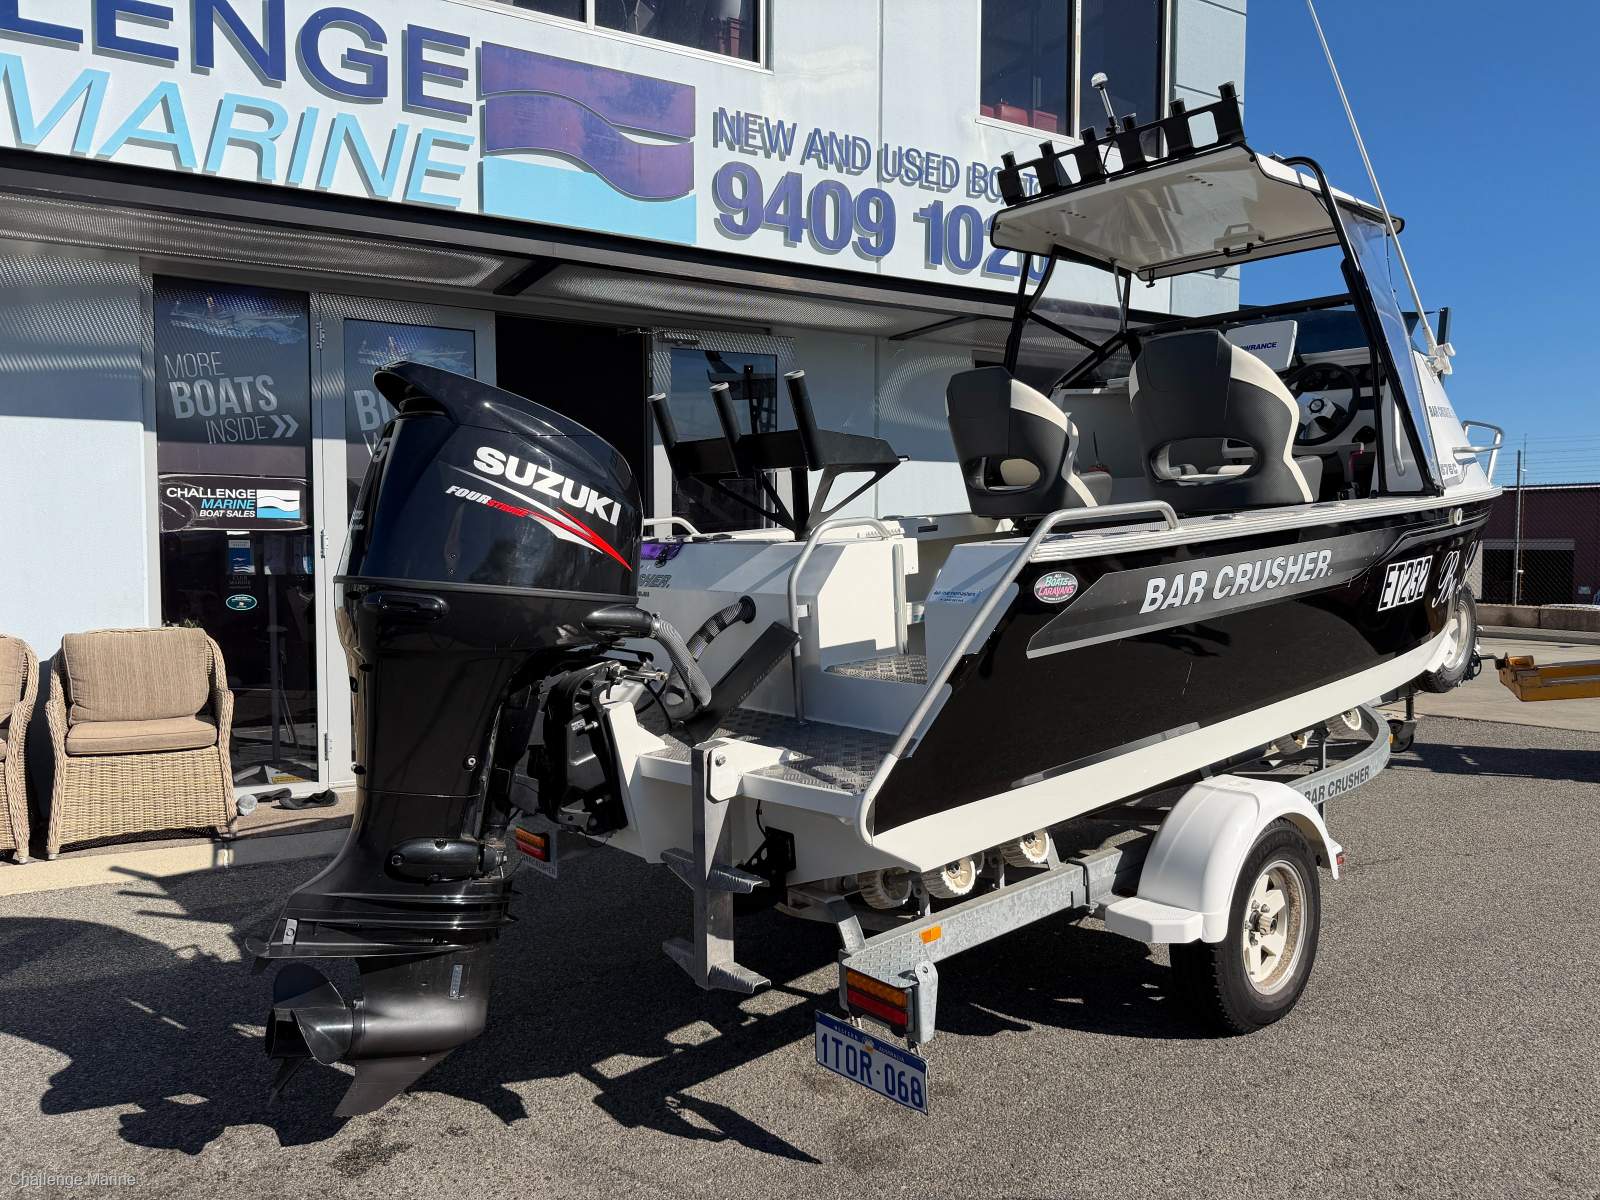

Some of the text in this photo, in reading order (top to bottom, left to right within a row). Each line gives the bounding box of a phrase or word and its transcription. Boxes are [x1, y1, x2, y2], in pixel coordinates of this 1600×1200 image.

[0, 53, 476, 208] MARINE
[715, 106, 797, 158] NEW
[805, 127, 871, 172] AND
[883, 143, 960, 188] USED
[716, 161, 896, 257] 9409
[165, 352, 221, 379] MORE
[169, 375, 277, 419] BOATS
[206, 415, 269, 444] INSIDE
[166, 487, 256, 499] CHALLENGE
[201, 498, 256, 510] MARINE
[473, 446, 622, 526] SUZUKI
[199, 509, 256, 518] BOAT SALES
[1139, 549, 1332, 614] BAR CRUSHER
[1305, 765, 1370, 803] BAR CRUSHER
